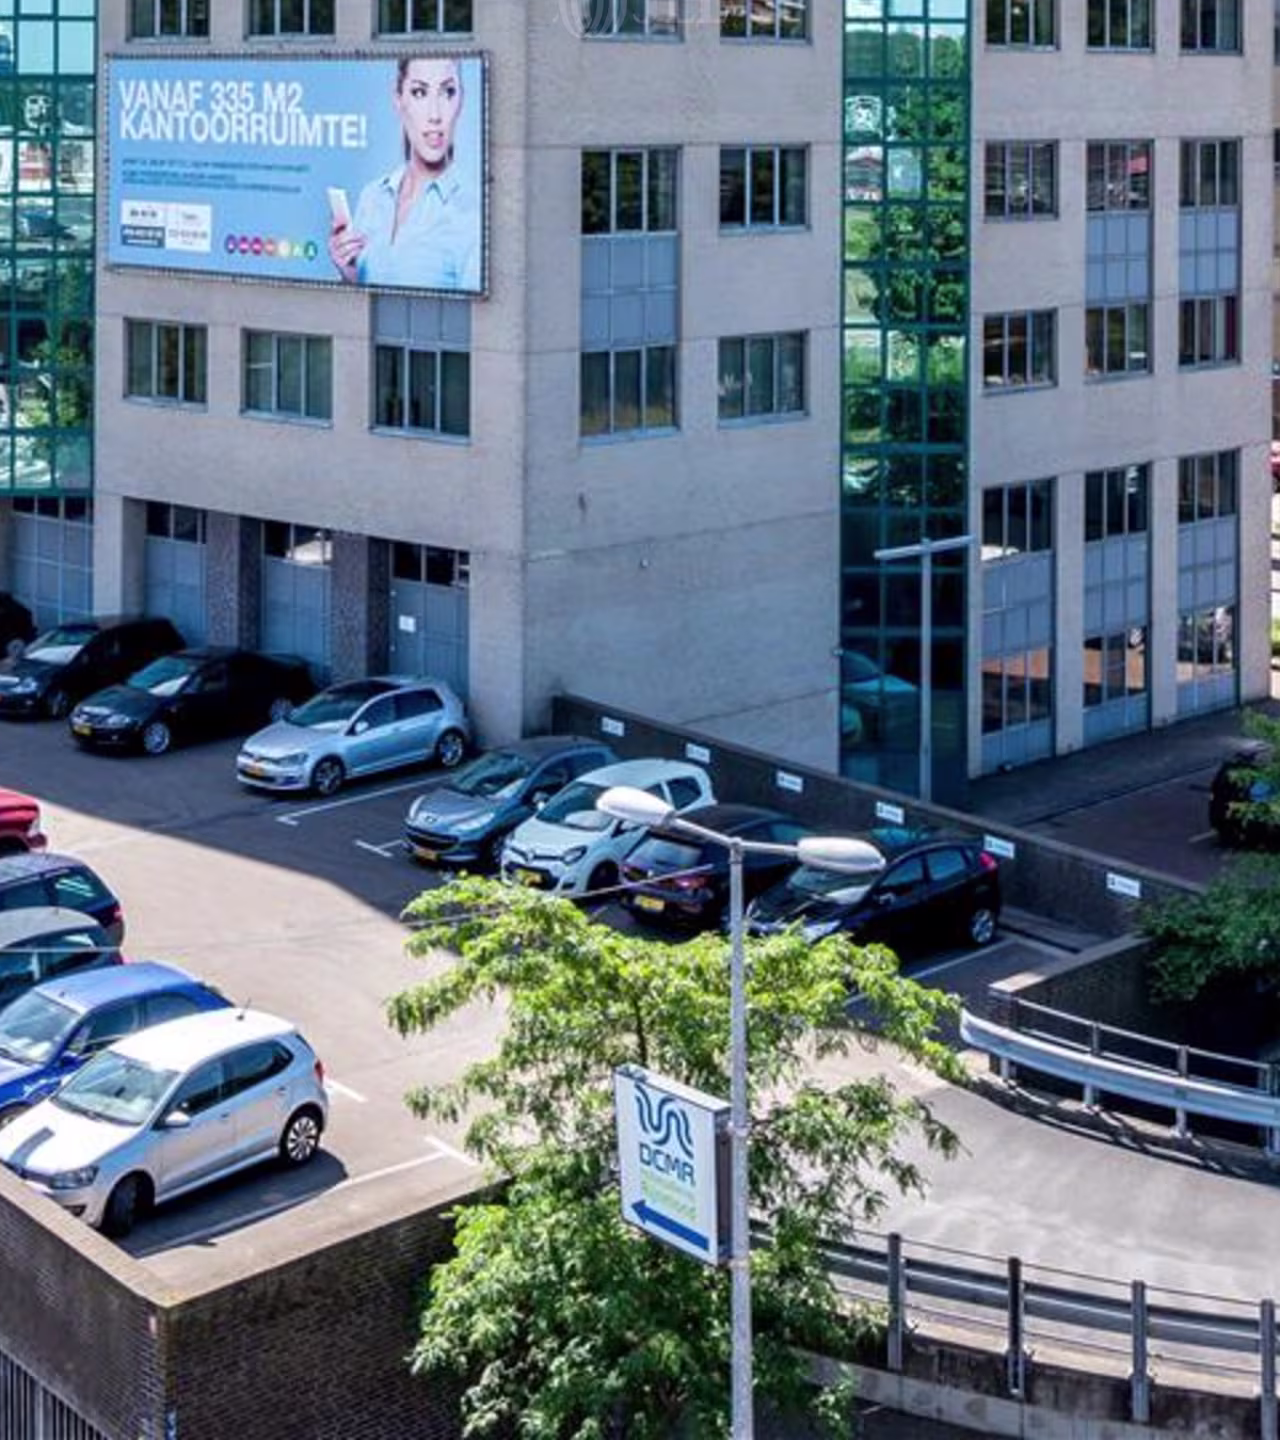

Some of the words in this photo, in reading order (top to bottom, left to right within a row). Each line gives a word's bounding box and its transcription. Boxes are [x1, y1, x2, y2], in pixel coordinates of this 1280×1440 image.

[118, 79, 203, 112] VANAF
[209, 80, 255, 113] 335
[263, 81, 303, 116] M2
[120, 110, 368, 148] KANTOORRUIMTE!
